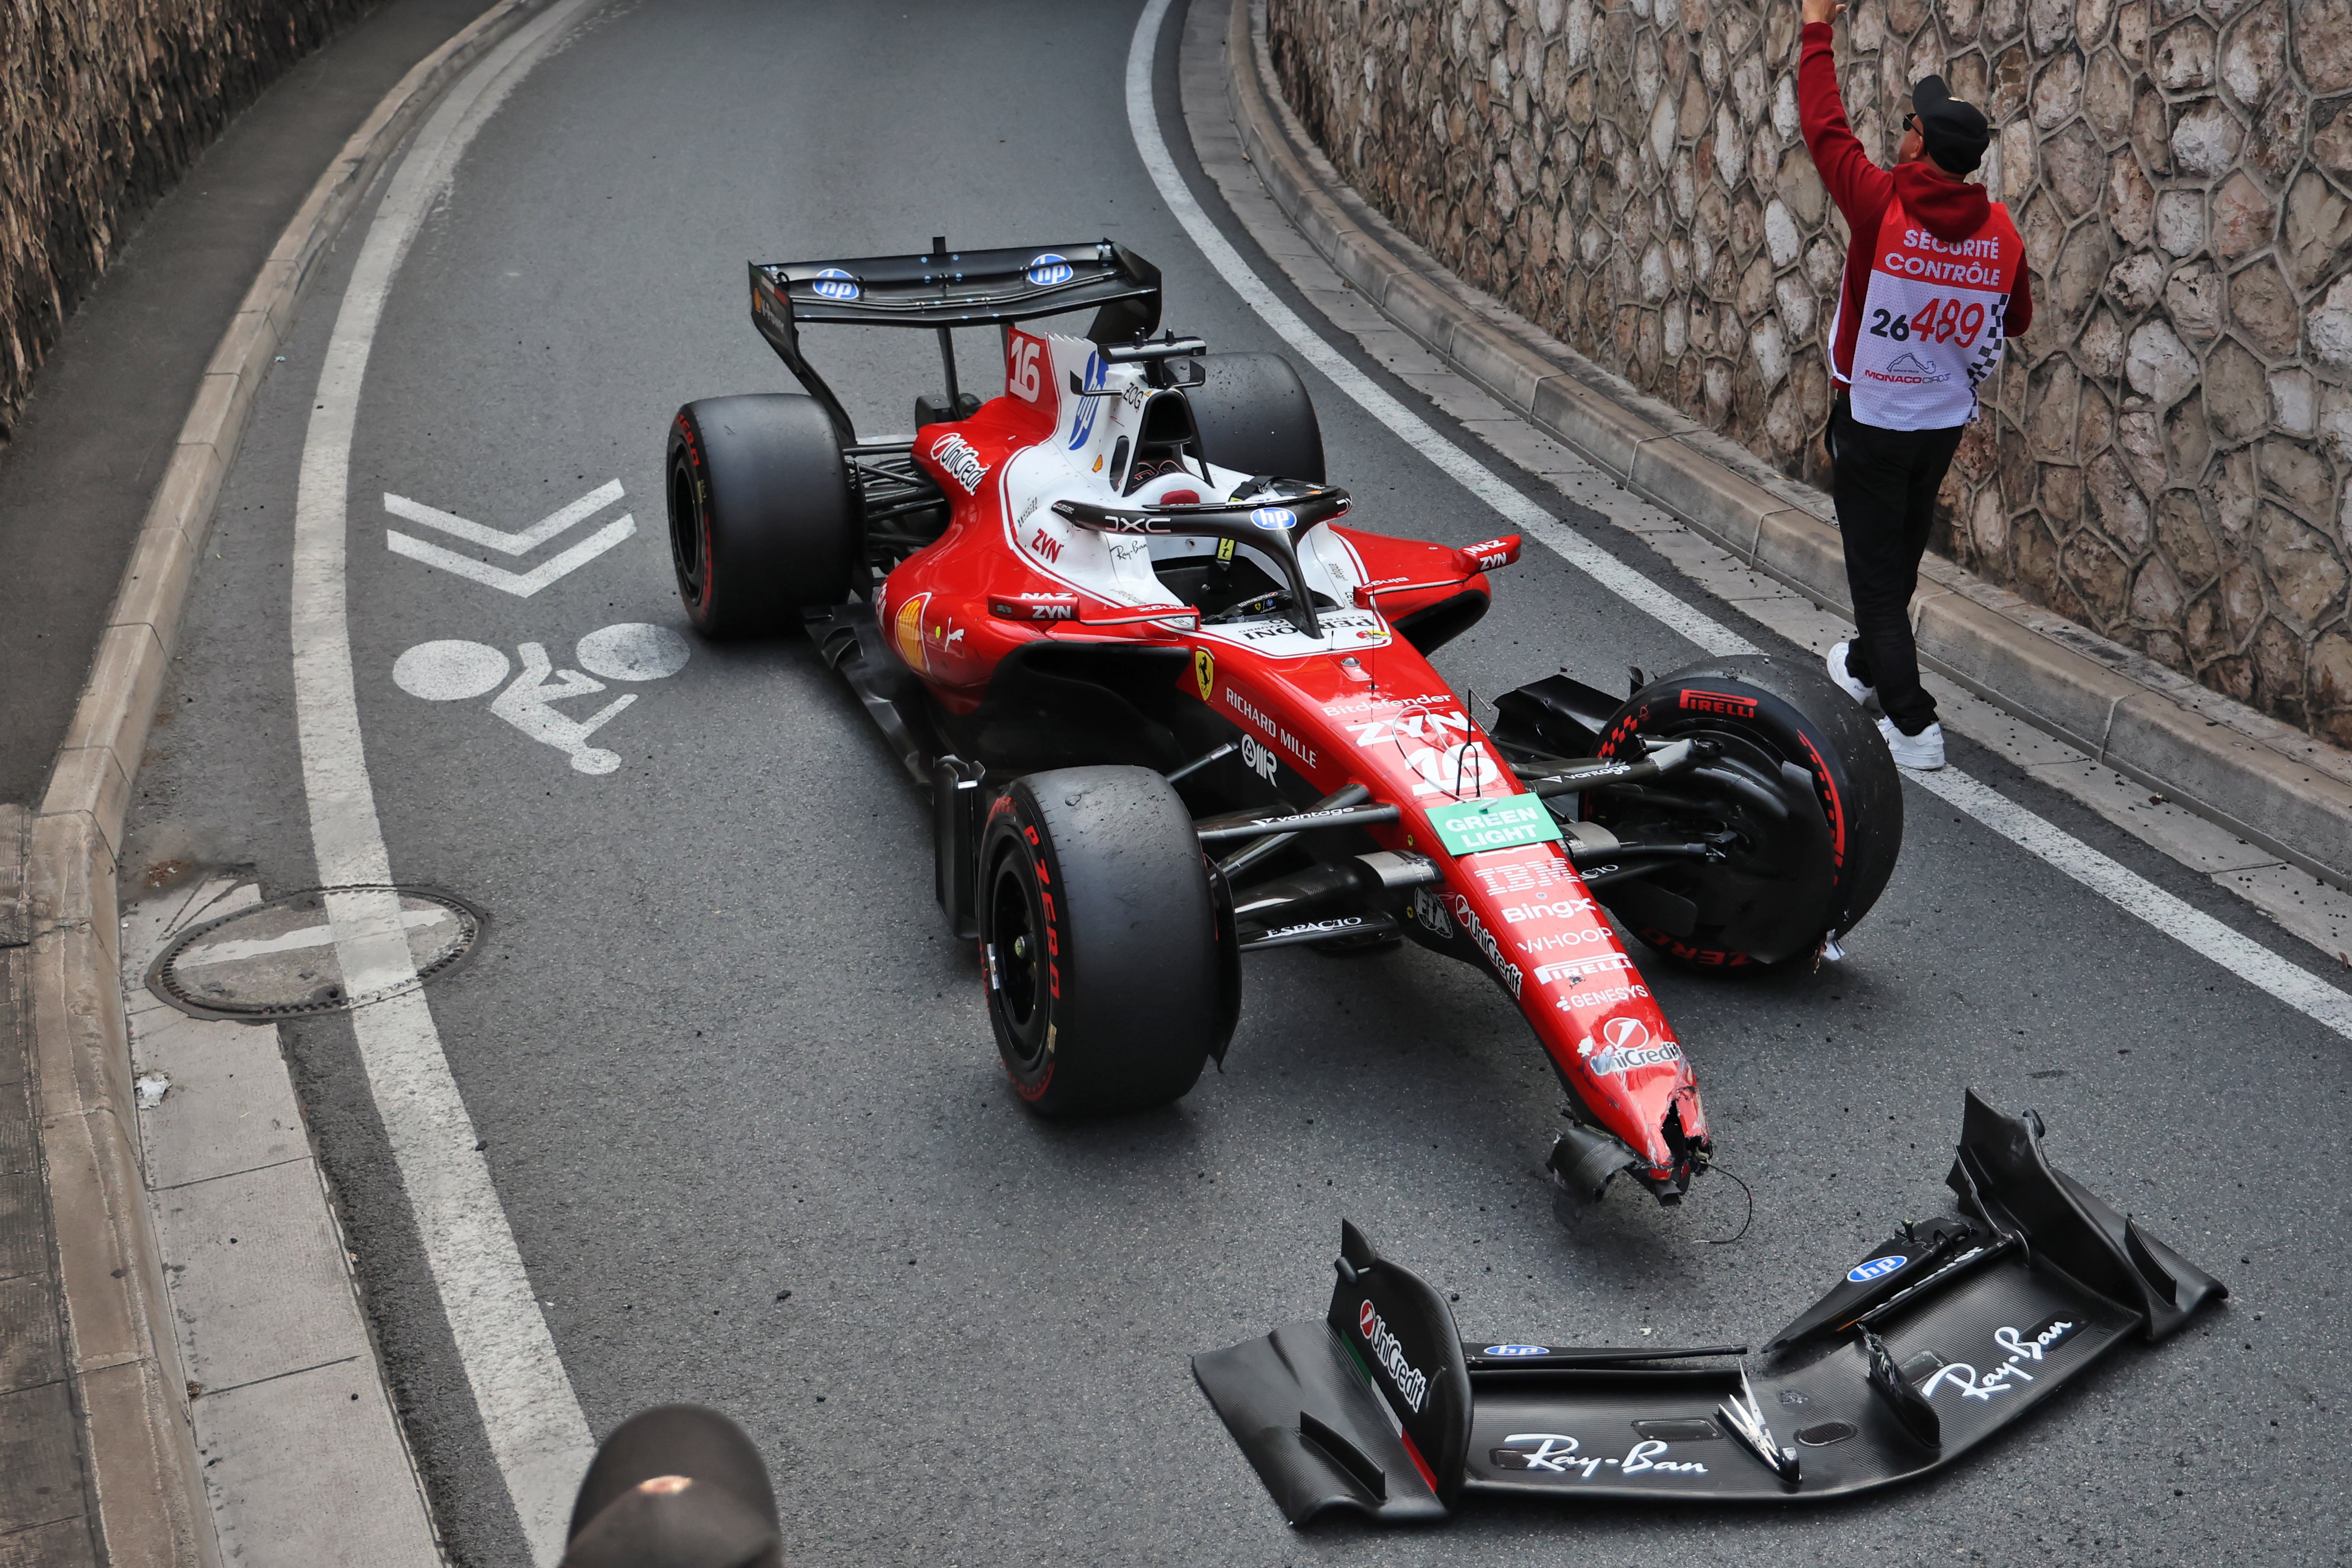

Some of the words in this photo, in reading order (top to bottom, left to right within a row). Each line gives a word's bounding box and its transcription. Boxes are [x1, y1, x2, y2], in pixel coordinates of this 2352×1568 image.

[1885, 252, 2000, 286] CONTRÔLE
[1869, 308, 1910, 342] 26
[1910, 298, 1985, 348] 489
[1009, 336, 1040, 403] 16
[1865, 369, 1922, 383] MONACO
[1123, 382, 1144, 410] ZCG
[1257, 508, 1291, 529] hp
[1031, 528, 1063, 564] ZYN
[1110, 540, 1148, 560] Ray-Ban
[1480, 552, 1508, 571] ZYN
[1033, 605, 1071, 619] ZYN
[1321, 694, 1451, 717] Bitdefender
[1679, 689, 1758, 718] PIRELLI
[1227, 687, 1276, 738] RICHARD
[1281, 728, 1316, 769] MILLE
[1345, 711, 1477, 747] ZYN
[1405, 741, 1498, 796] 16
[1565, 764, 1632, 780] vantage
[1277, 806, 1356, 822] vantage
[1445, 806, 1539, 832] GREEN
[1461, 824, 1537, 848] LIGHT
[1474, 857, 1581, 897] IBM
[1024, 825, 1039, 846] P
[1035, 858, 1060, 999] ZERO
[1266, 916, 1362, 938] ESPACIO
[1517, 927, 1613, 953] WHOOP
[1469, 910, 1523, 1000] UniCredit
[1534, 952, 1634, 985] PIRELLI
[1570, 985, 1649, 1007] GENESYS
[1853, 1256, 1898, 1280] hp
[1372, 1315, 1426, 1413] UniCredit
[1495, 1345, 1539, 1355] hp
[1922, 1317, 2073, 1400] Ray-Ban
[1503, 1433, 1709, 1477] Ray-Ban
